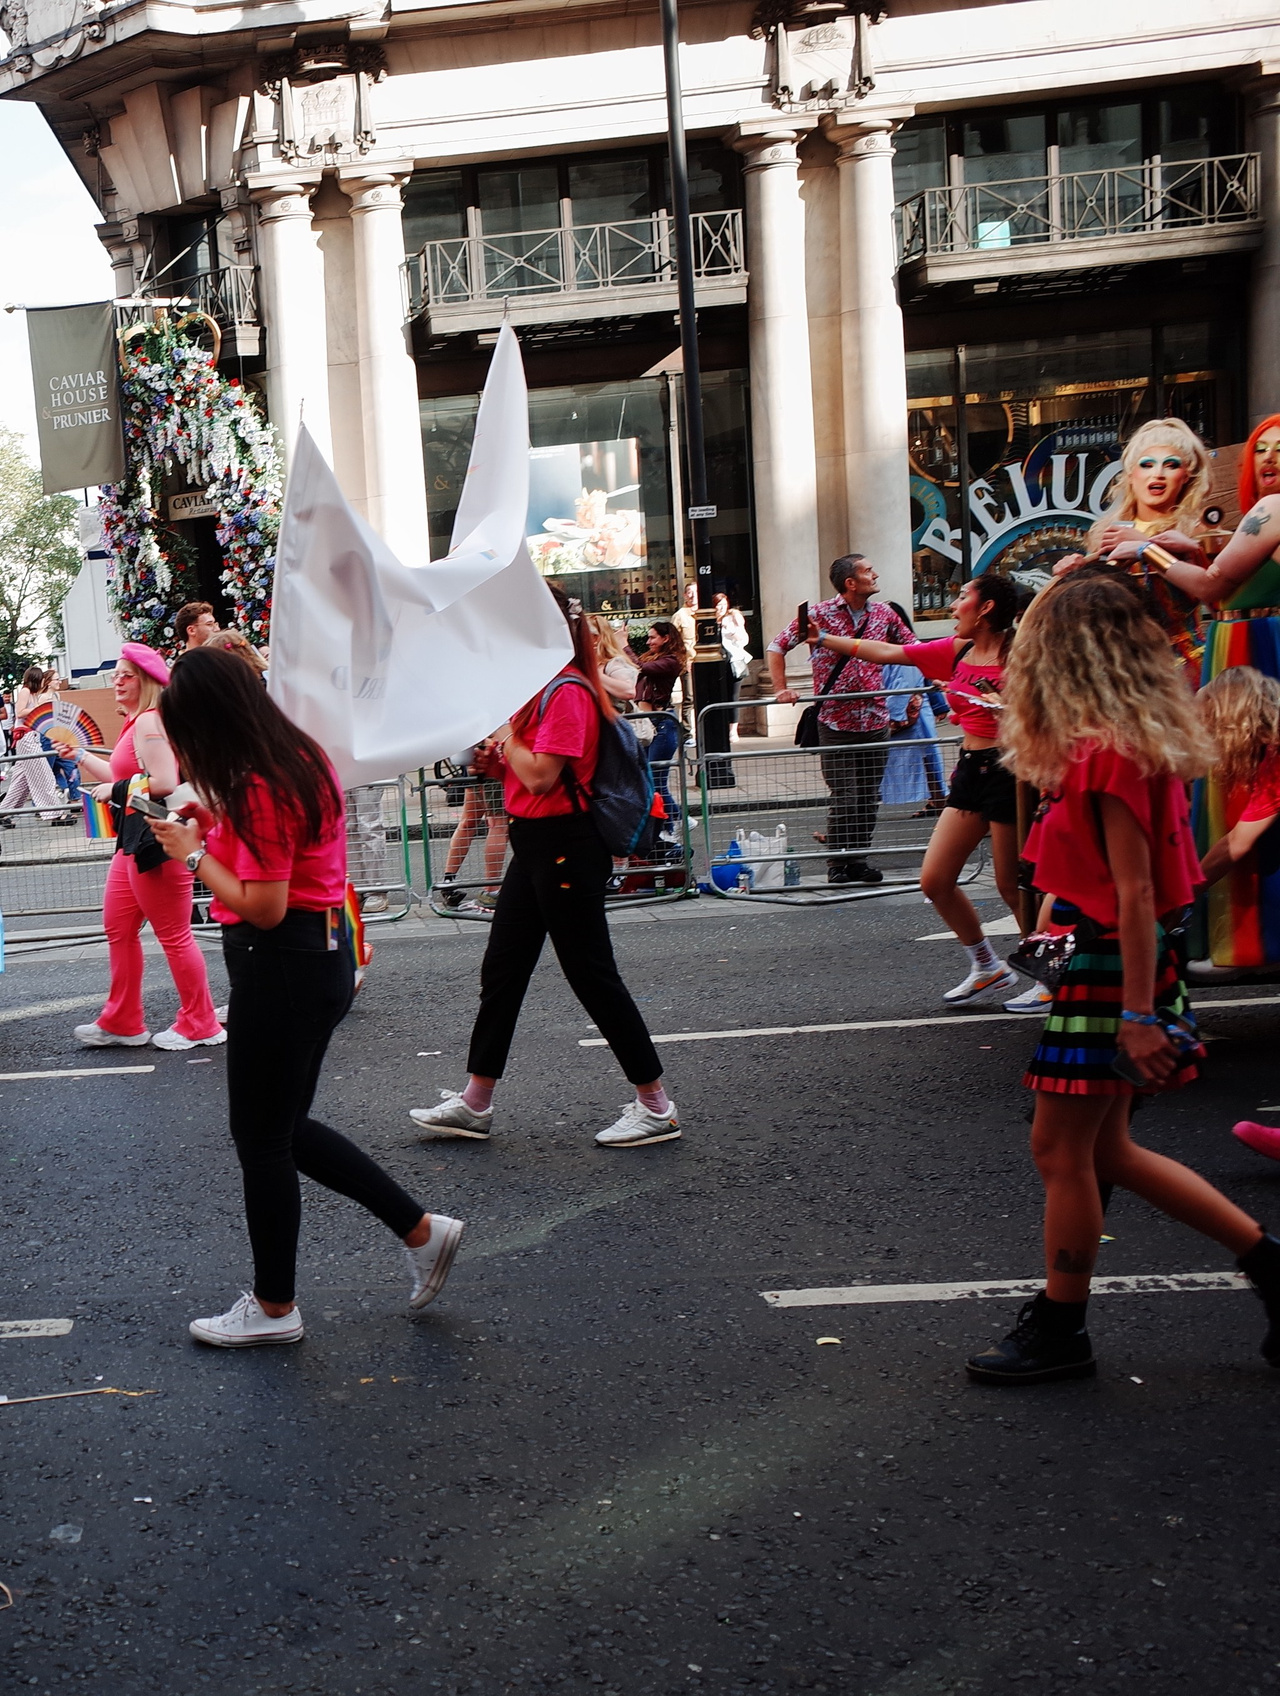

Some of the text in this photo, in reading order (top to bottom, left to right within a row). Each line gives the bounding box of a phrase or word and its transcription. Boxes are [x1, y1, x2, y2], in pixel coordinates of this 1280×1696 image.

[49, 370, 108, 391] CAVIAR
[51, 385, 108, 407] HOUSE
[53, 408, 112, 430] PRUNIER
[699, 564, 712, 575] 62
[601, 599, 613, 611] &
[604, 611, 646, 621] IFESTYLE
